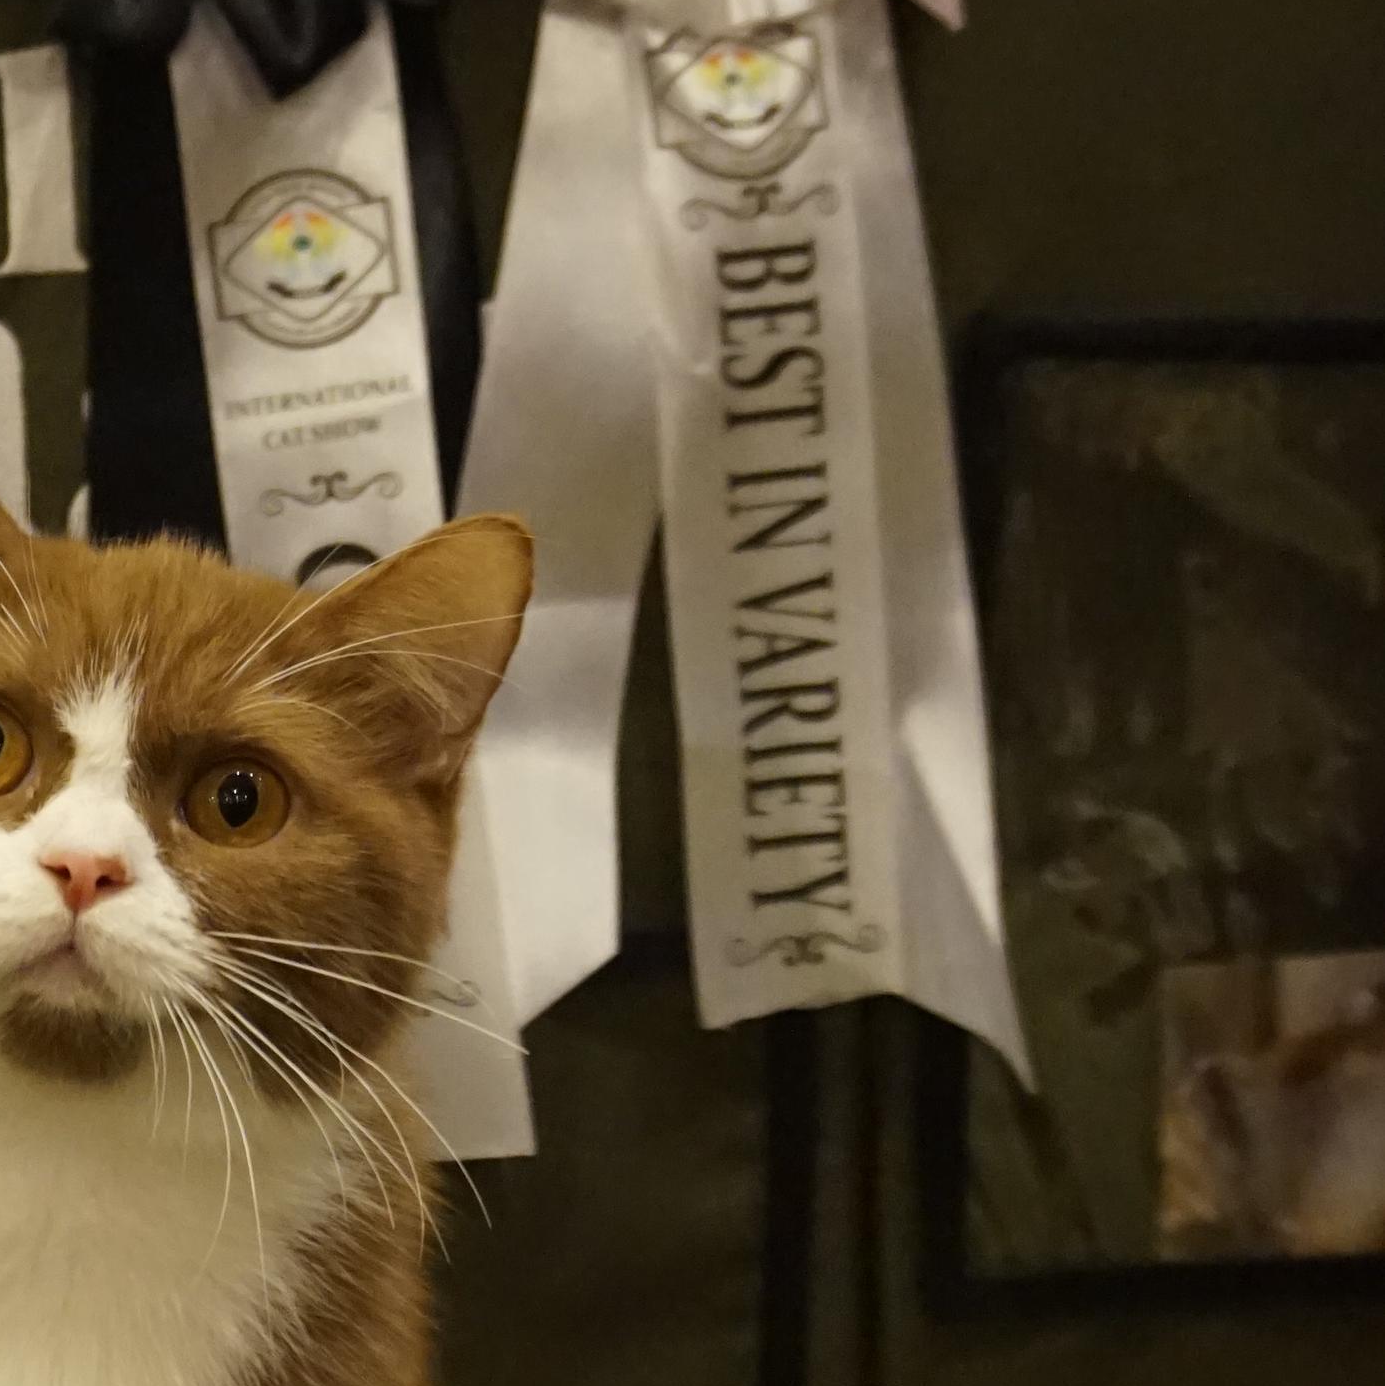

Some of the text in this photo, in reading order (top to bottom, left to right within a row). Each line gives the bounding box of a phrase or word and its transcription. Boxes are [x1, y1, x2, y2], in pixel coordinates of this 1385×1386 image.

[225, 374, 411, 421] INTERNATIONAL
[262, 416, 381, 451] CAT SHOW
[715, 240, 851, 915] BEST IN VARIETY
